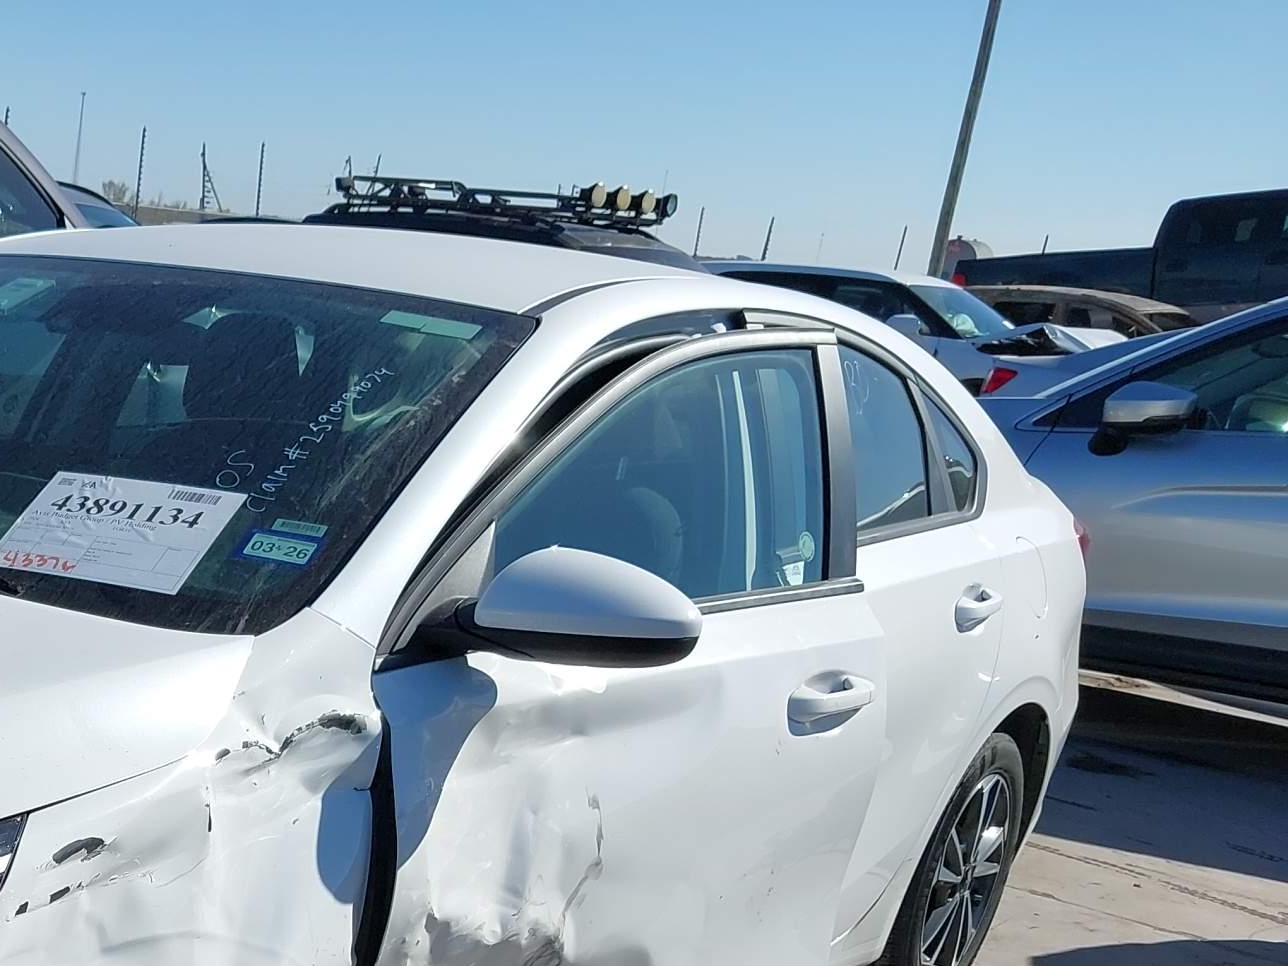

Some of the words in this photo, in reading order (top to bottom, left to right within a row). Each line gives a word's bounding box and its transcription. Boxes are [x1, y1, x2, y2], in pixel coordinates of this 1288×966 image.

[49, 493, 205, 529] 43891134
[51, 510, 79, 522] Budget
[79, 514, 105, 524] Group
[123, 519, 157, 532] Holding
[250, 540, 276, 553] 03
[283, 545, 311, 560] 26
